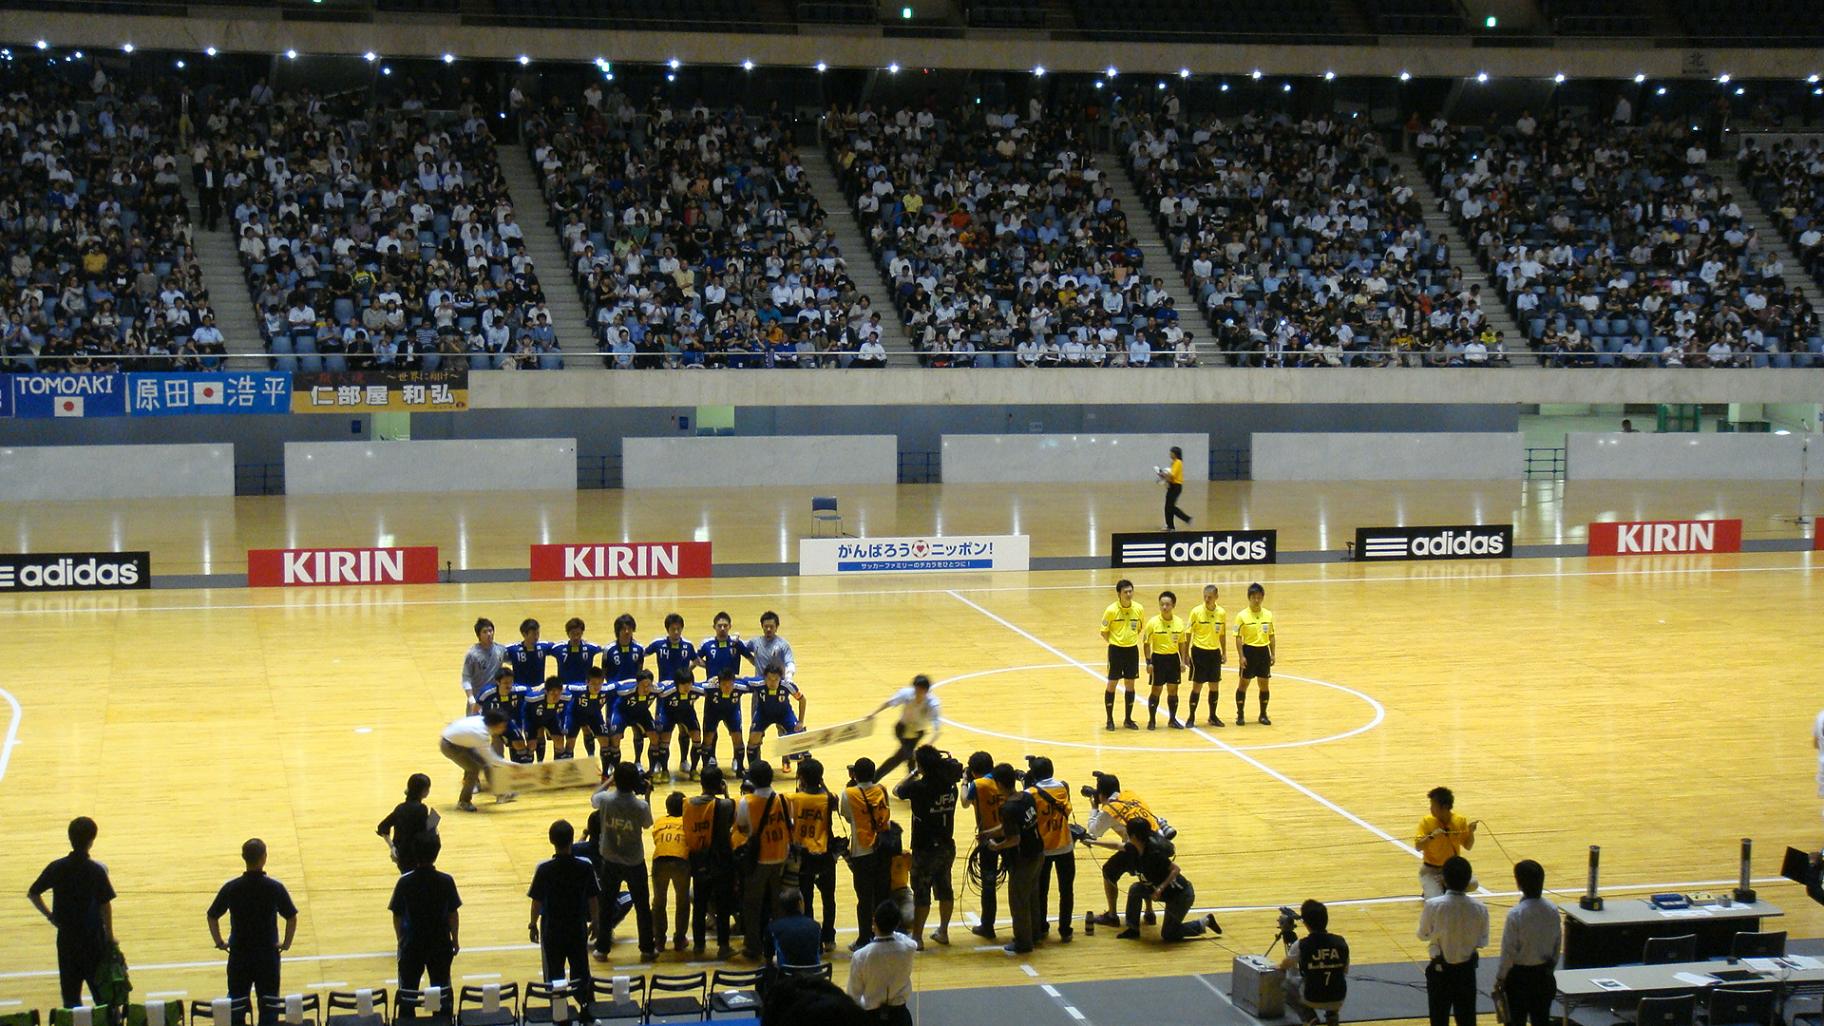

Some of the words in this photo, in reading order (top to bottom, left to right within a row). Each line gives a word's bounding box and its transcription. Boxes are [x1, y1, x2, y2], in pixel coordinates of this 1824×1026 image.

[16, 375, 113, 395] TOMOAKI
[136, 378, 190, 411] 原田
[227, 375, 286, 407] 浩平
[310, 385, 389, 406] 仁部屋
[402, 384, 455, 405] 和弘
[1411, 531, 1504, 556] adidas
[1617, 523, 1715, 553] KIRIN
[838, 543, 910, 559] がんばろう
[1169, 537, 1267, 562] adidas
[282, 549, 405, 584] KIRIN
[564, 545, 680, 578] KIRIN
[20, 558, 139, 587] adidas
[516, 652, 527, 663] 18
[613, 654, 621, 665] 8
[659, 648, 670, 659] 14
[578, 698, 589, 708] 15
[935, 795, 955, 805] JFA
[797, 808, 823, 820] JFA
[605, 818, 633, 832] JFA
[660, 833, 681, 844] 104
[1312, 948, 1340, 960] JFA
[1323, 972, 1332, 986] 7
